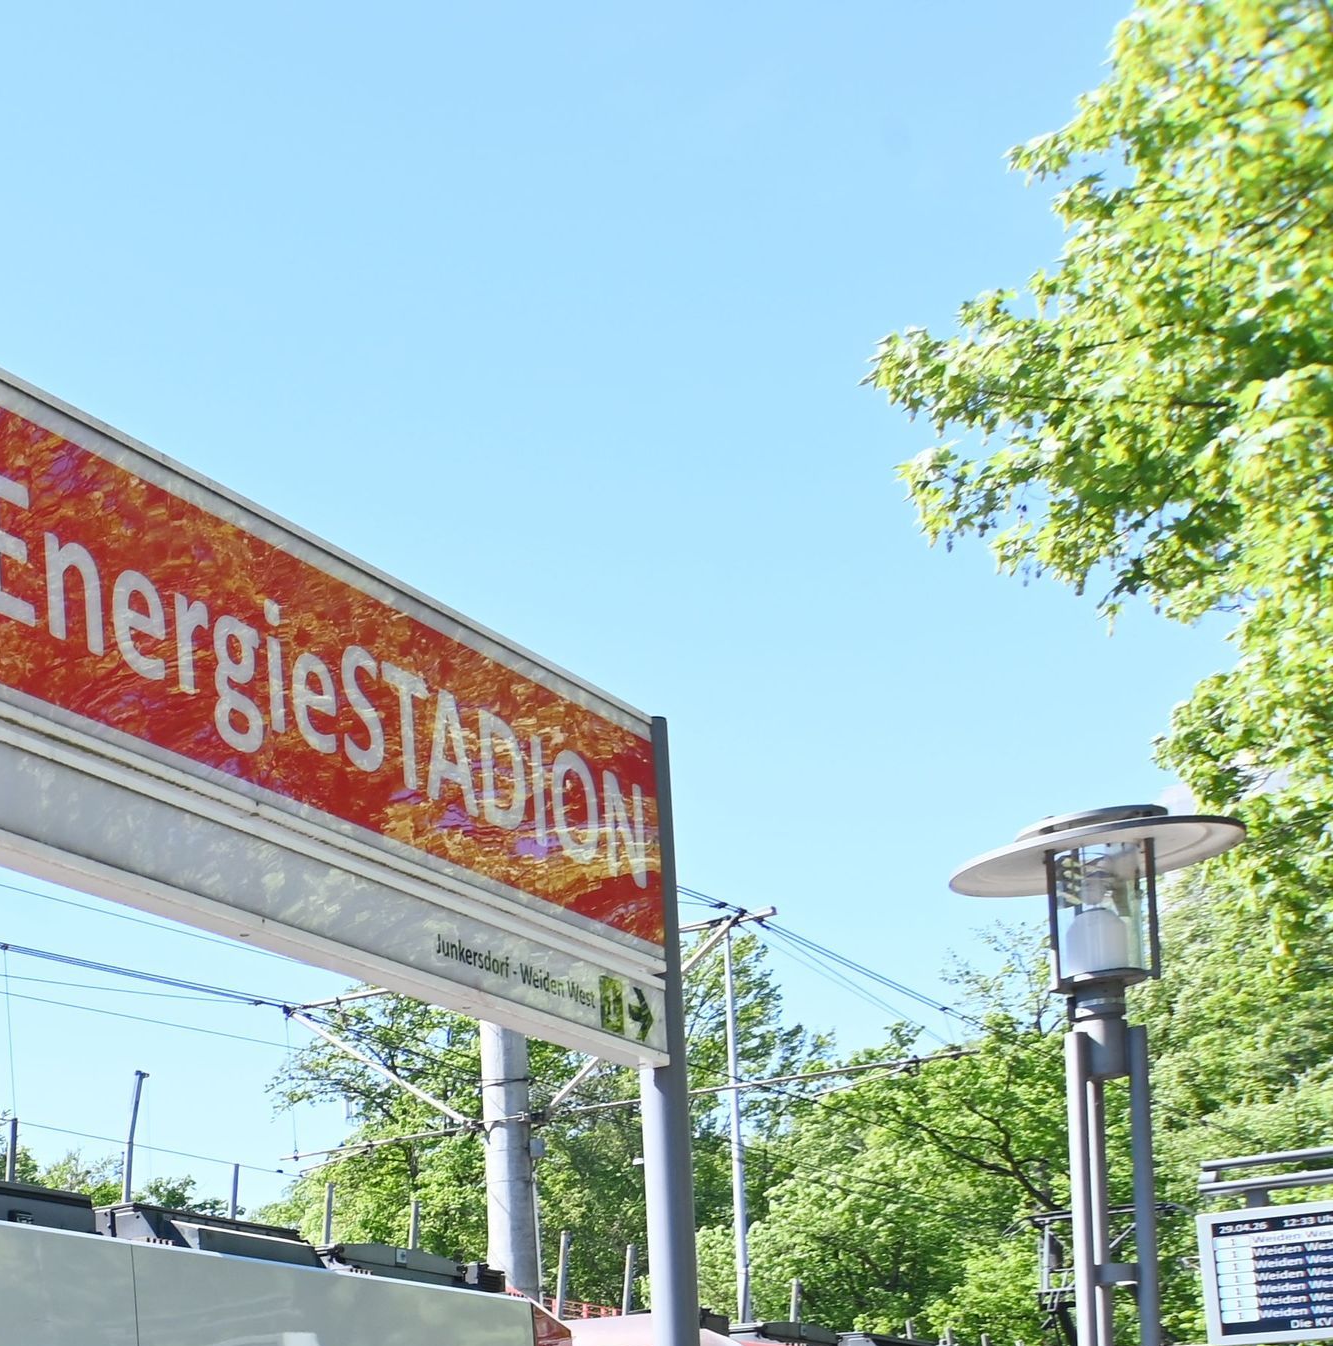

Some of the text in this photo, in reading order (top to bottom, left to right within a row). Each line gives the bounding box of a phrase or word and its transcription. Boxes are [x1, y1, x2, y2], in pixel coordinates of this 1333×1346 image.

[436, 933, 509, 978] Junkersdorf
[520, 962, 565, 998] Weiden
[567, 980, 596, 1009] West
[1219, 1221, 1268, 1234] 29.04.26
[1282, 1216, 1315, 1228] 12:33
[1253, 1244, 1302, 1257] Weiden
[1255, 1257, 1303, 1269] Weiden
[1256, 1269, 1304, 1281] Weiden
[1257, 1282, 1306, 1293] Weiden
[1258, 1294, 1307, 1306] Weiden
[1259, 1307, 1309, 1318] Weiden
[1290, 1319, 1314, 1329] Die
